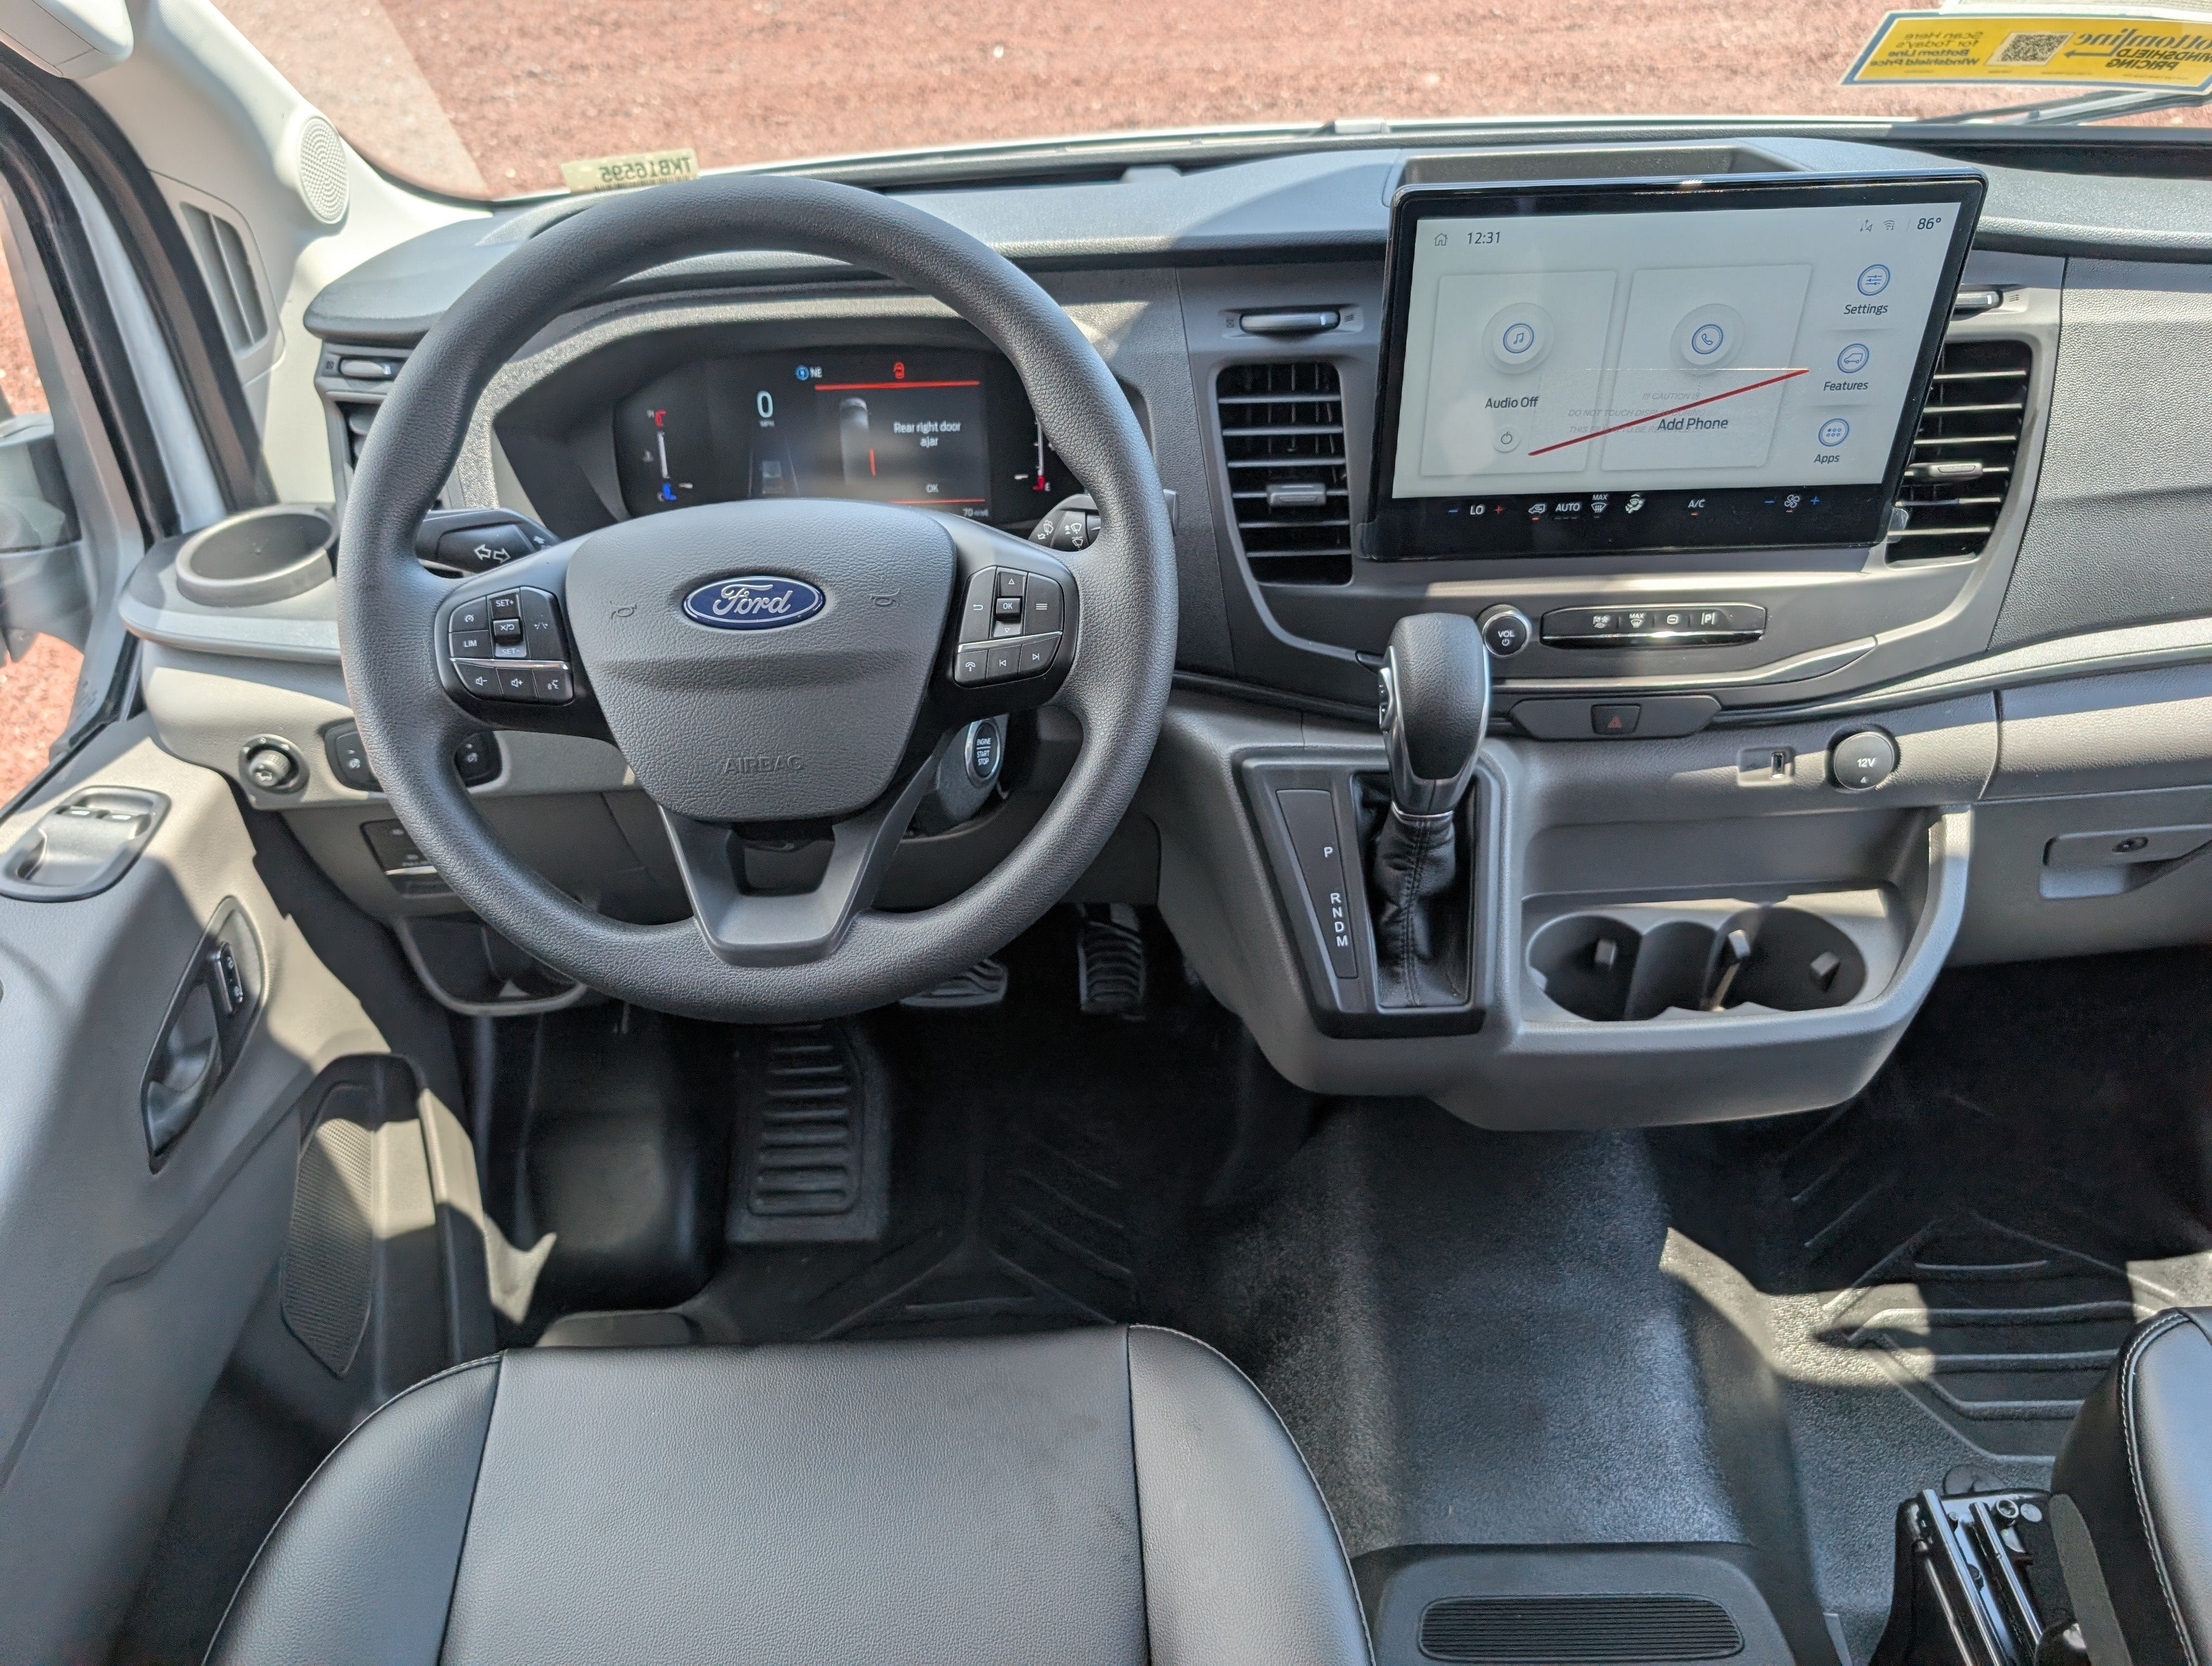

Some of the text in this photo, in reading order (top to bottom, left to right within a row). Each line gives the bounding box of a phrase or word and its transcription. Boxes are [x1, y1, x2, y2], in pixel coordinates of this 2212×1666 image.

[1917, 217, 1941, 230] 86°
[1467, 232, 1501, 244] 12:31
[1843, 304, 1888, 315] Settings
[1823, 381, 1868, 391] Features
[757, 390, 773, 418] 0
[1485, 396, 1539, 408] Audio Off
[893, 420, 961, 434] Rear right door
[1657, 418, 1684, 431] Add
[1686, 417, 1729, 430] Phone
[920, 436, 938, 448] ajar
[1814, 454, 1840, 464] Apps
[1555, 502, 1580, 512] AUTO
[1687, 498, 1706, 508] A/C
[1470, 504, 1485, 515] LO
[496, 599, 515, 607] SET+
[712, 584, 794, 616] Ford
[1497, 630, 1515, 638] VOL
[976, 749, 990, 758] START
[723, 754, 805, 773] AIRBAG
[978, 758, 989, 766] STOP
[1857, 757, 1876, 768] 12V
[1323, 846, 1333, 858] P
[1330, 892, 1342, 904] R
[1332, 906, 1343, 918] N
[1334, 921, 1345, 933] D
[1336, 935, 1348, 947] M
